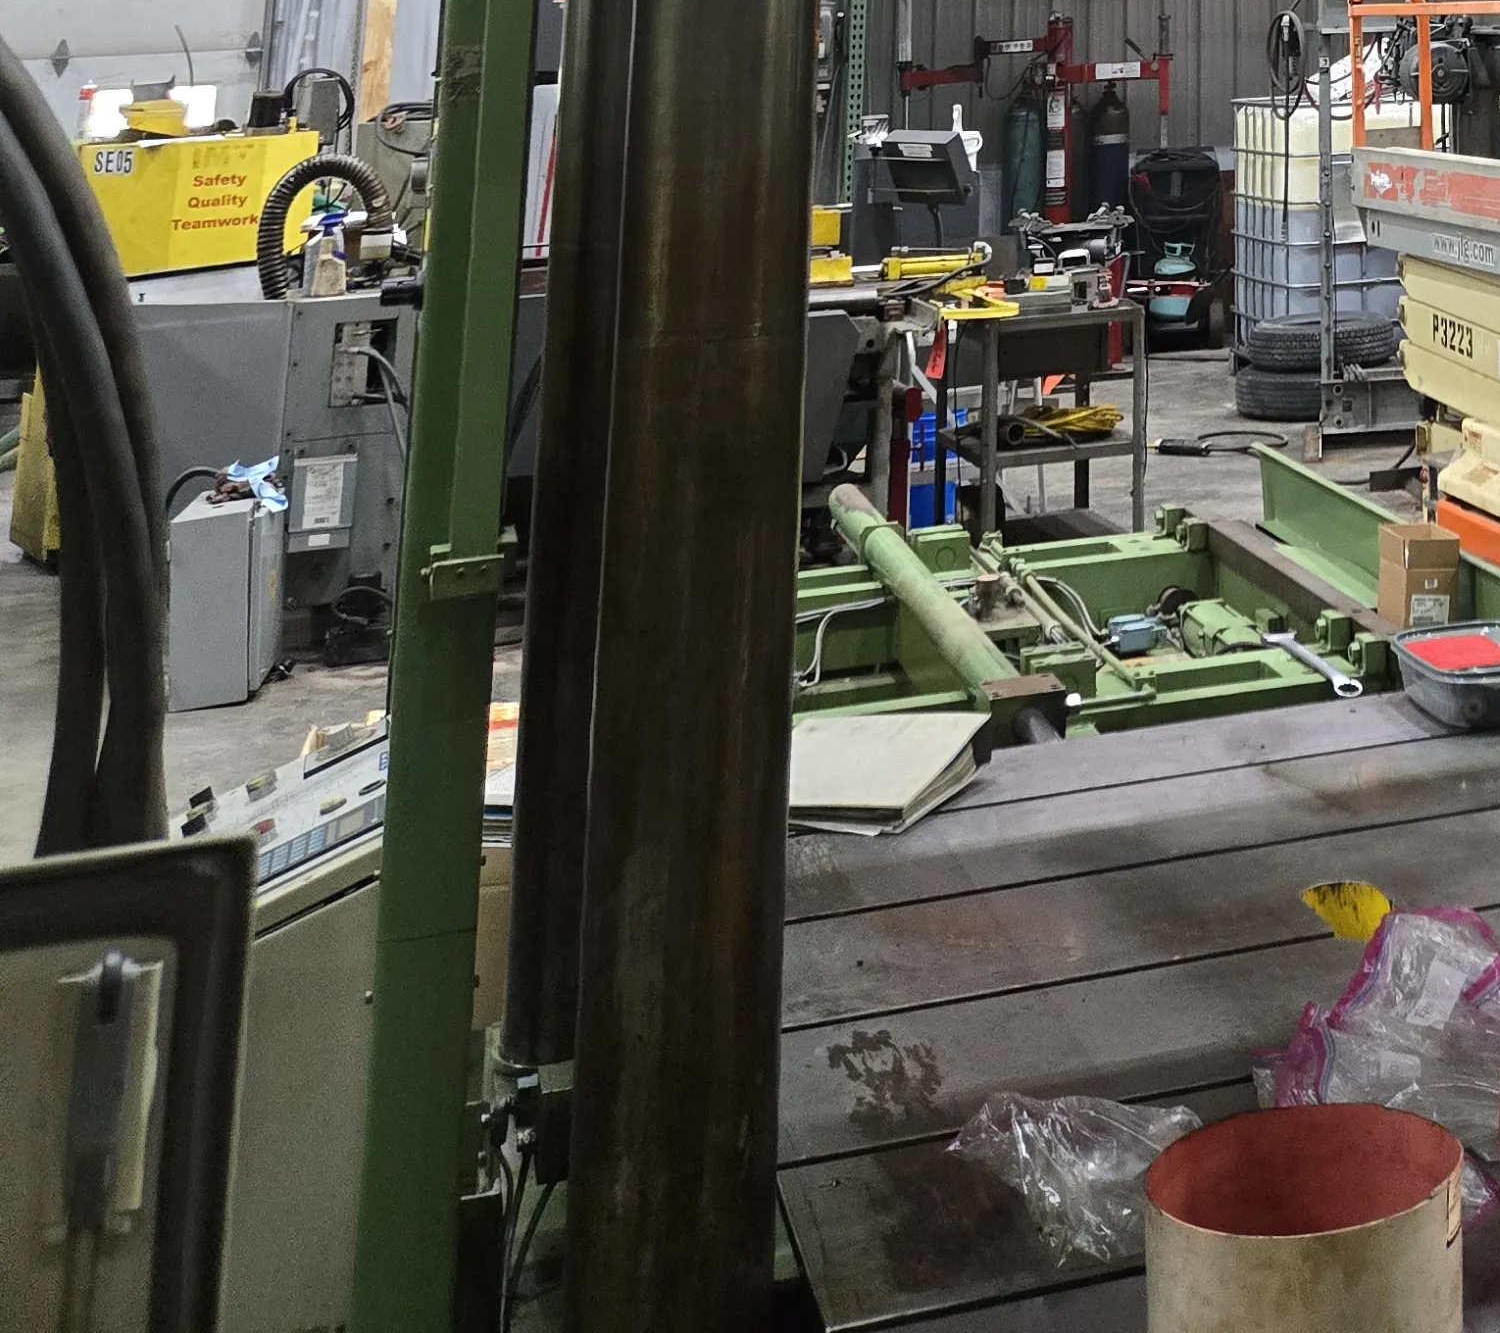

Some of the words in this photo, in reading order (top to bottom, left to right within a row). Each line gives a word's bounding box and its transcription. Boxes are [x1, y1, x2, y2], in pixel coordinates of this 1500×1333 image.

[94, 149, 133, 174] SE05
[193, 174, 247, 188] Safety
[188, 195, 248, 209] Quality
[171, 214, 259, 231] Teamwork
[1433, 234, 1495, 266] www.jlg.com
[1432, 313, 1473, 359] P3223
